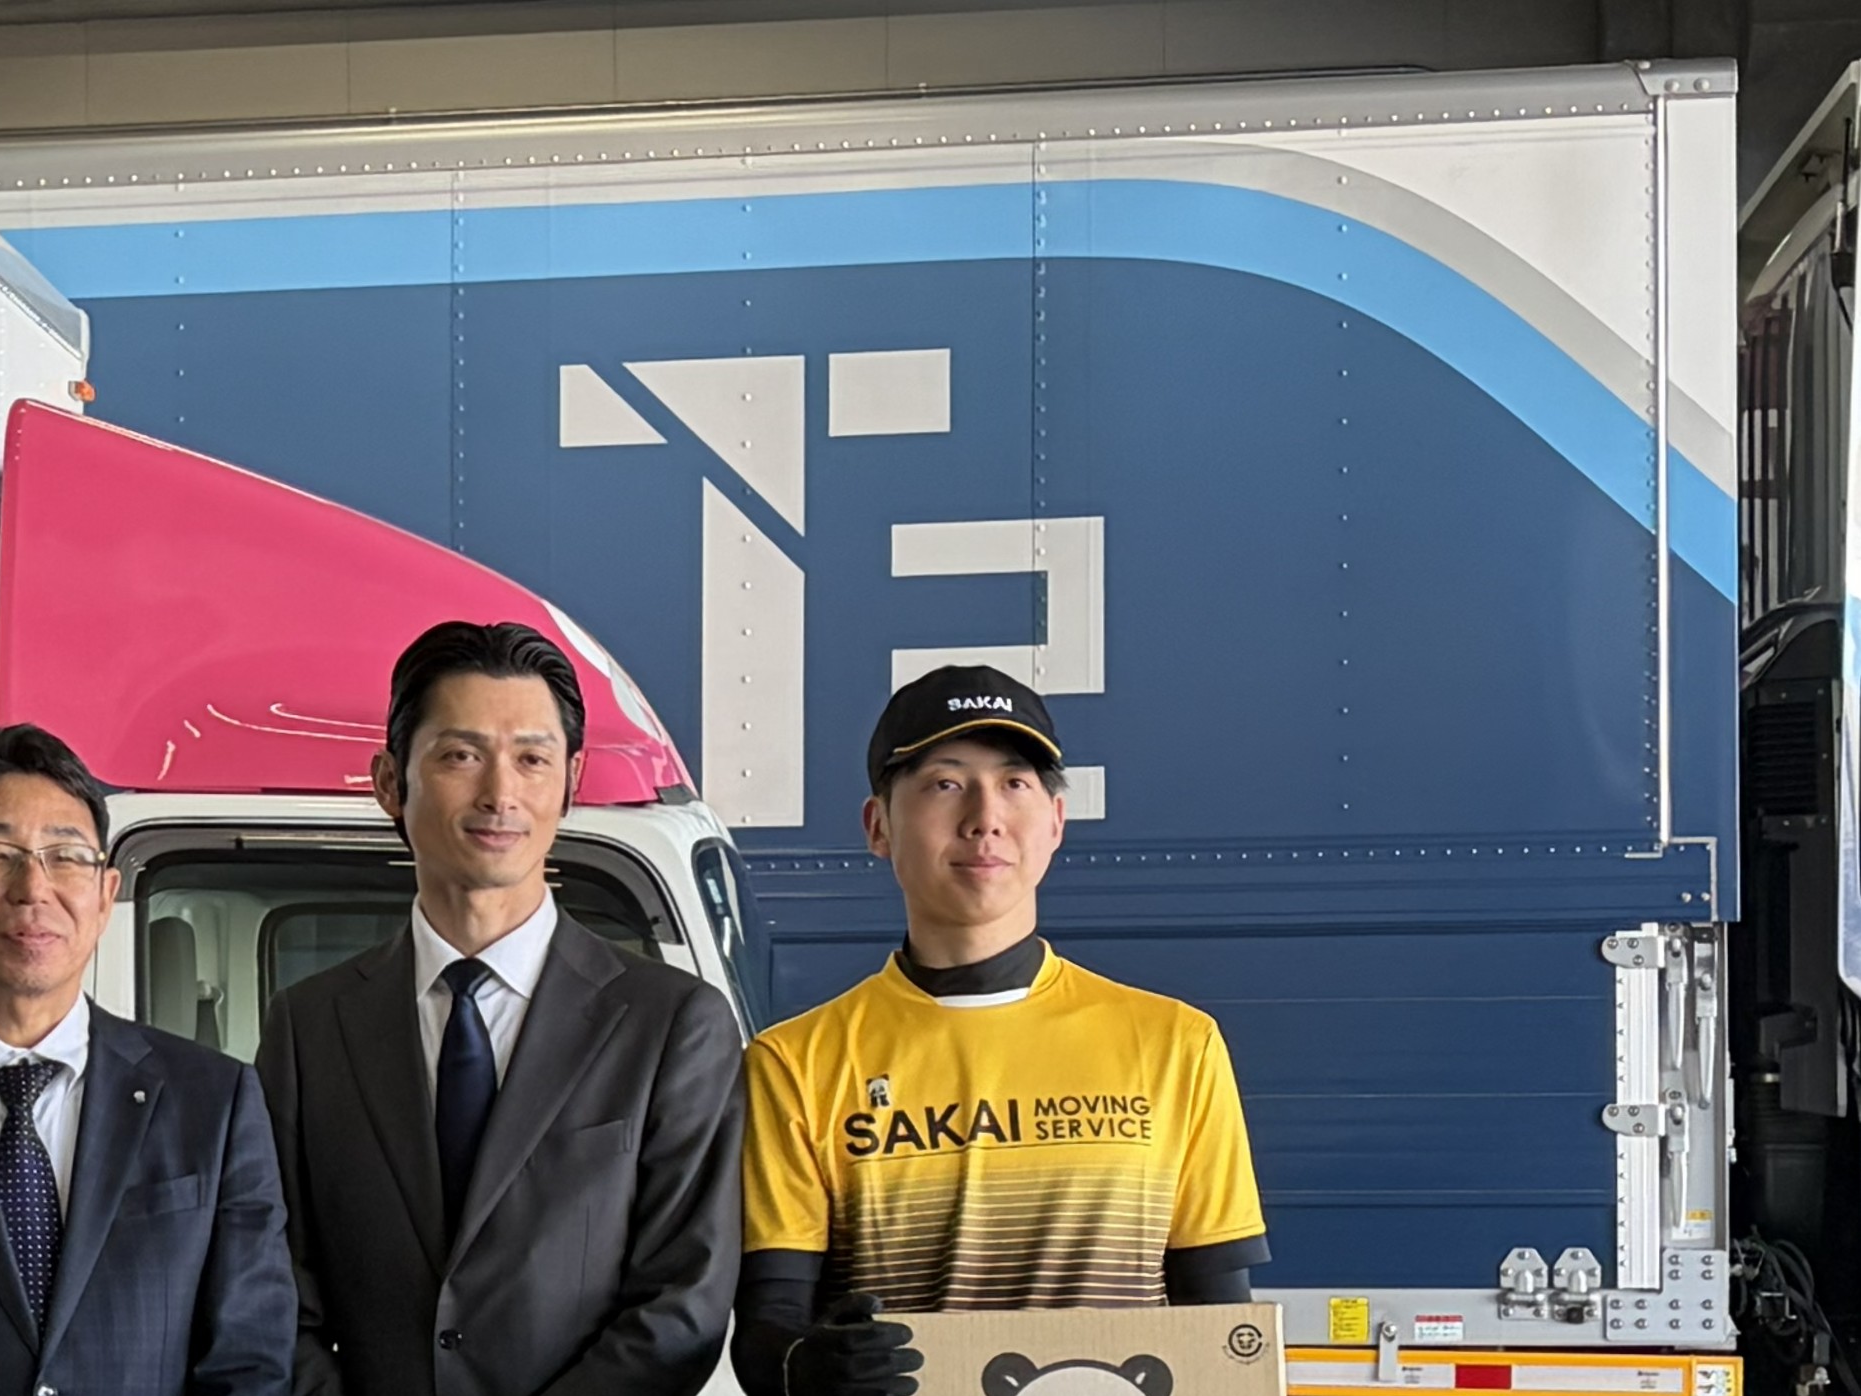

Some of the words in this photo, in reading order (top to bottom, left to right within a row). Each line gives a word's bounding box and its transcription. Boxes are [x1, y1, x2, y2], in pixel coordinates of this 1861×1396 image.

[1034, 1095, 1151, 1118] MOVING
[844, 1098, 1022, 1157] SAKAI
[1035, 1117, 1152, 1140] SERVICE
